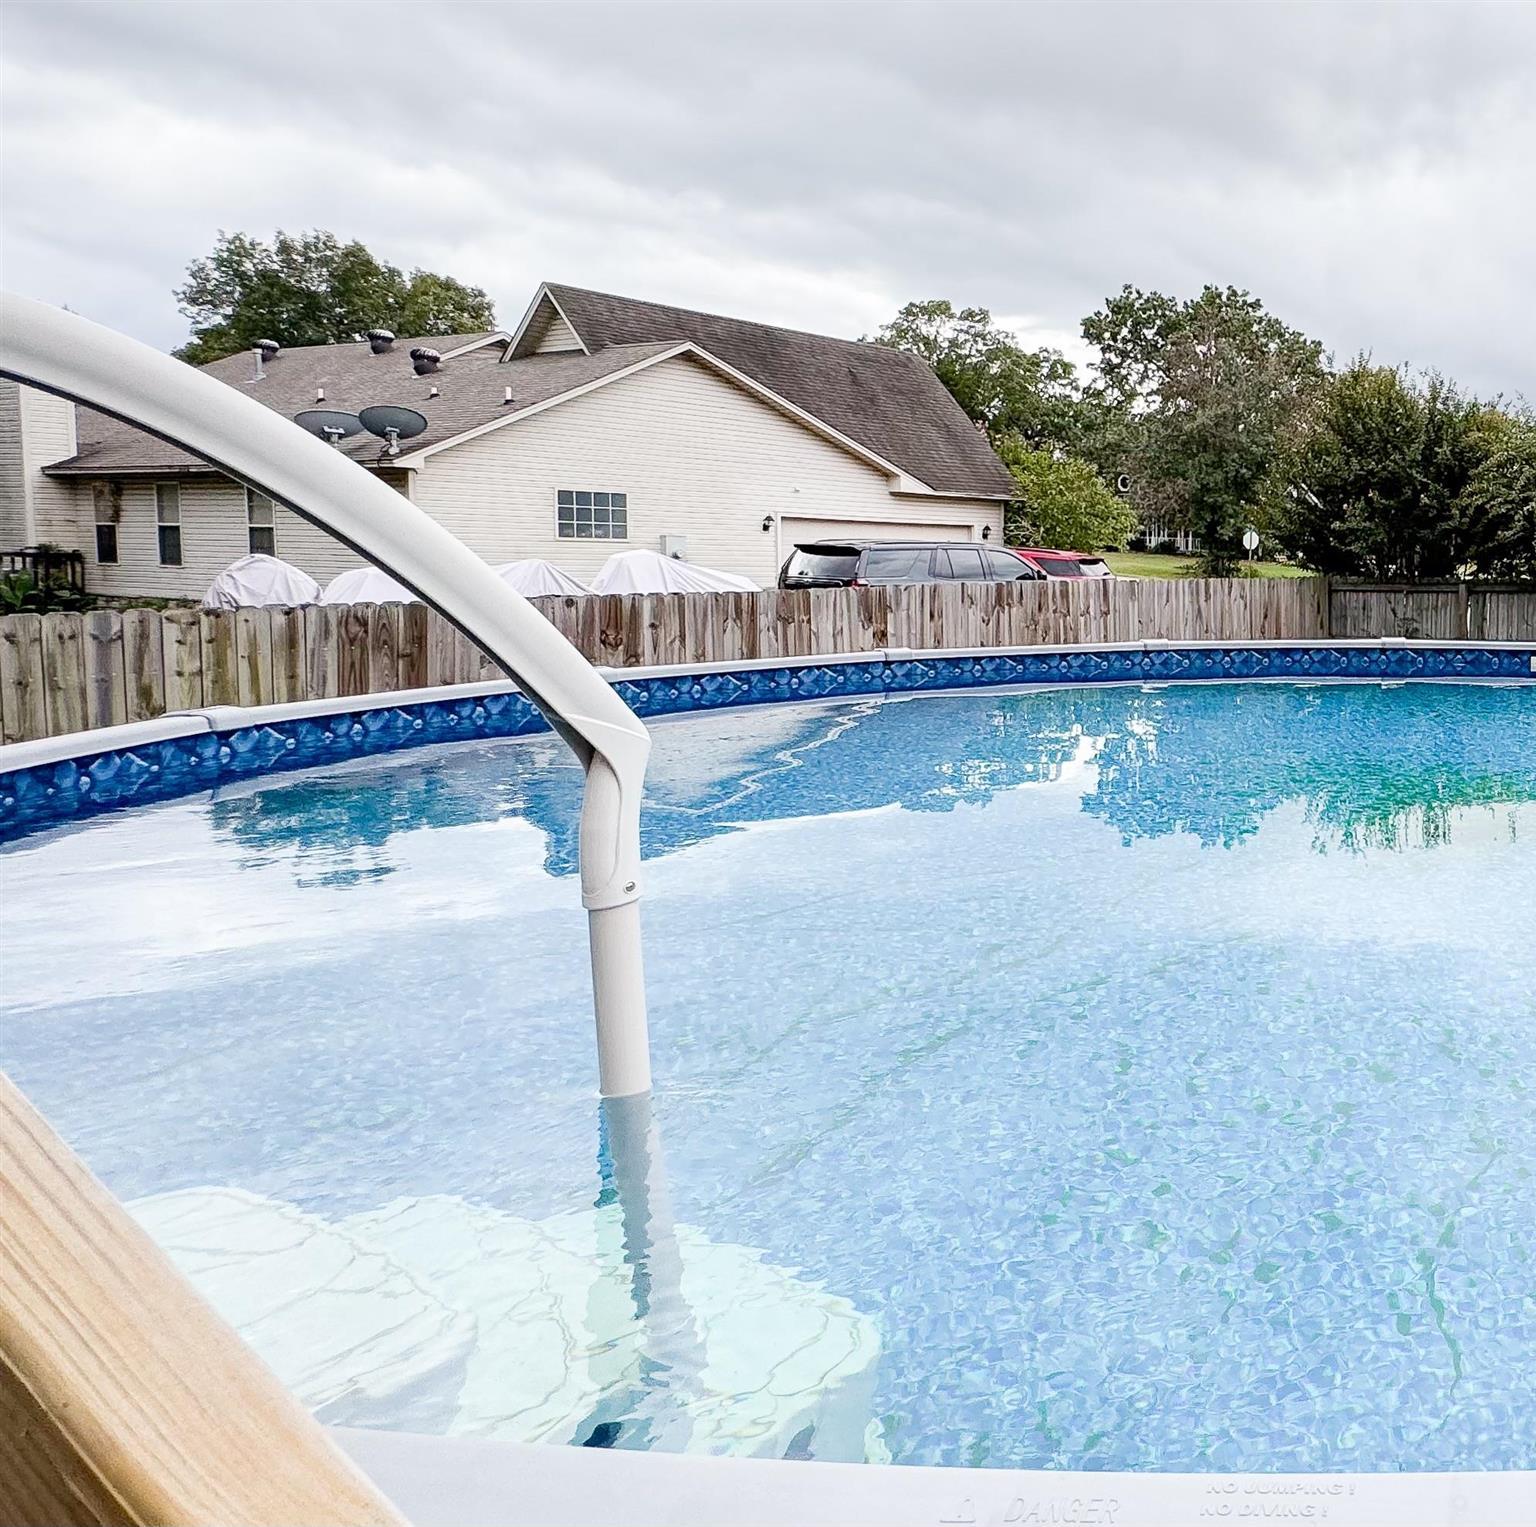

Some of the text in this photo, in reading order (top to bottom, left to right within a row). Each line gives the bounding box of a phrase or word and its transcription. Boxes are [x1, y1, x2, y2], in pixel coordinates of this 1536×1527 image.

[1206, 1481, 1239, 1495] NO
[1002, 1497, 1121, 1525] DANGER
[1199, 1503, 1233, 1517] NO
